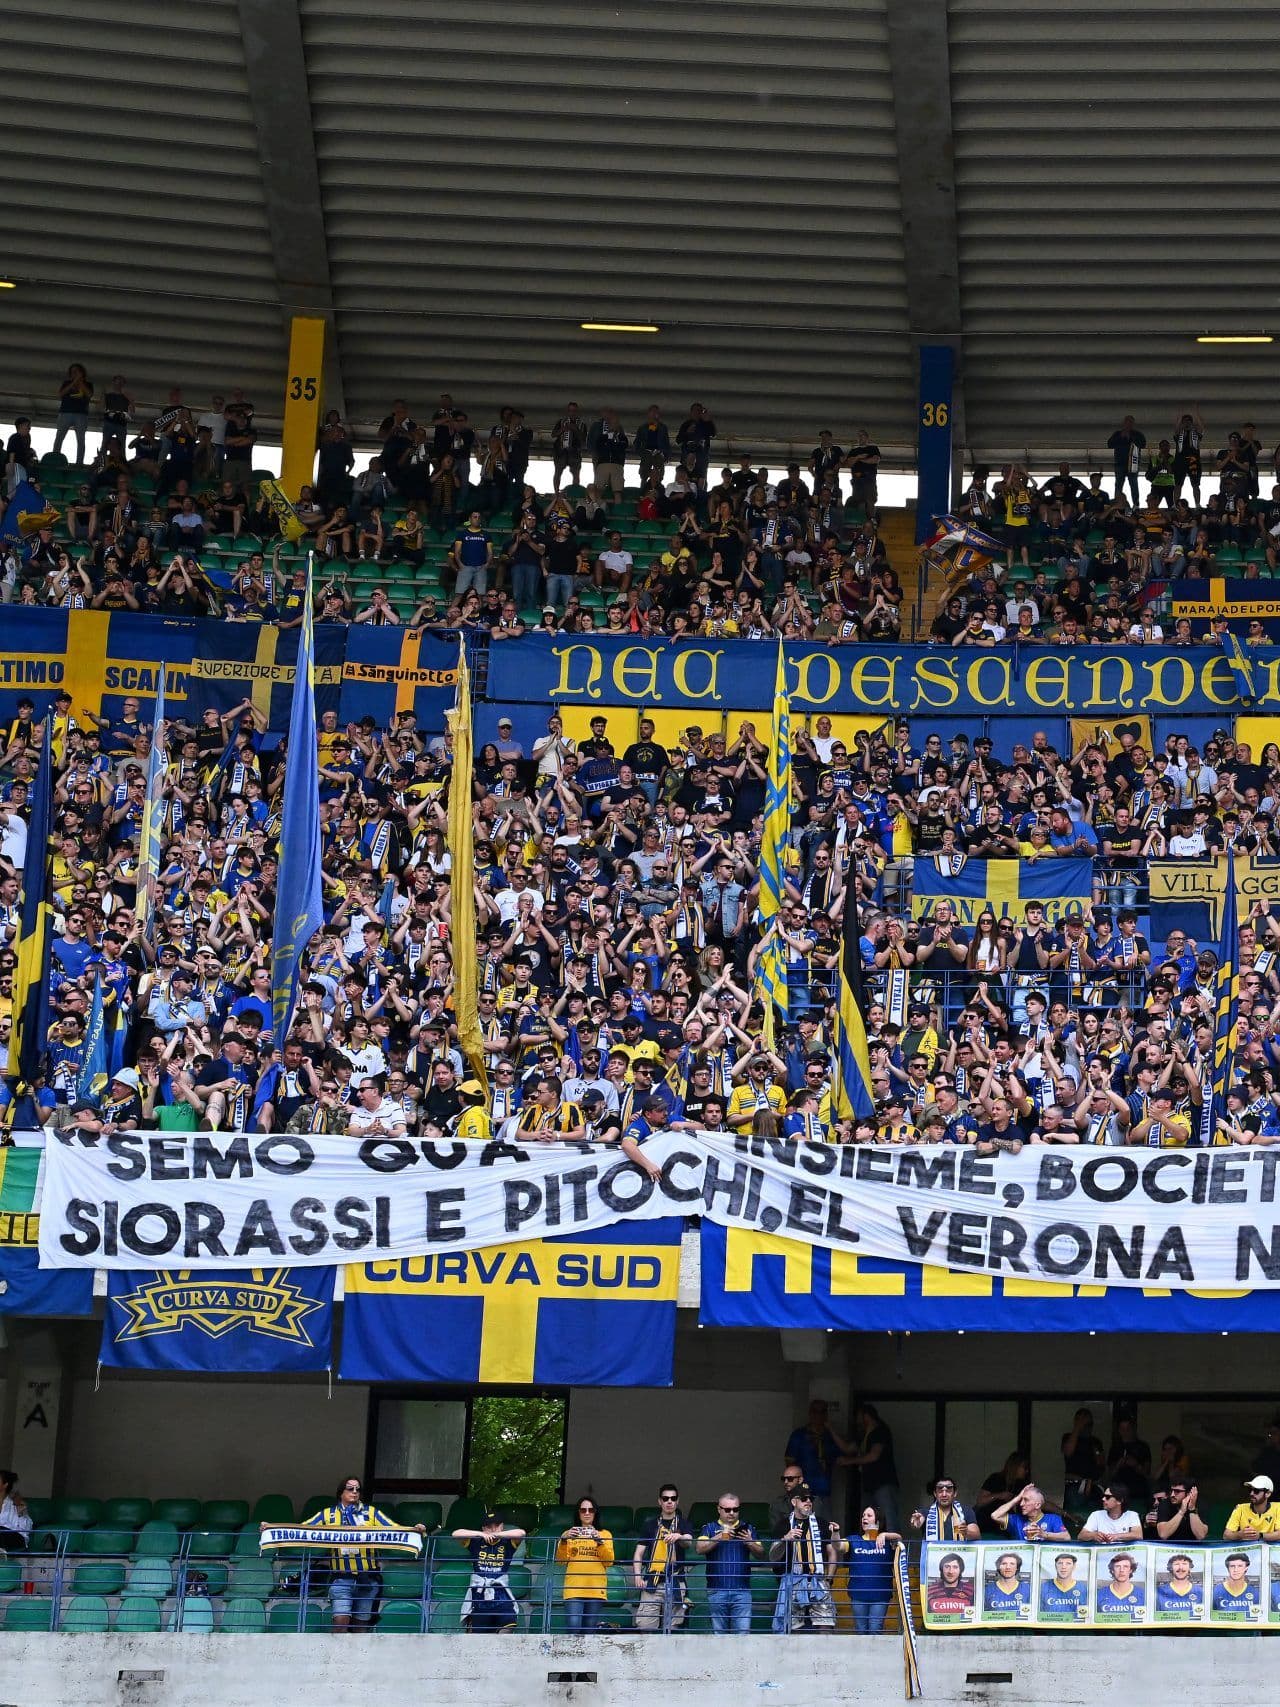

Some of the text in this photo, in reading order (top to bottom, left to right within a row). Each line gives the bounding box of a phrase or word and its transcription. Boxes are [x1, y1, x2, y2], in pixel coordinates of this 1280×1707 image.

[290, 377, 317, 401] 35
[923, 402, 947, 426] 36
[0, 660, 64, 684] TIMO
[549, 644, 725, 700] NEC
[59, 1195, 391, 1258] SIORASSI
[426, 1187, 467, 1243] E
[896, 1205, 1195, 1282] VERONA
[363, 1251, 663, 1289] CURVA SUD
[158, 1290, 279, 1312] CURVA SUD
[270, 1530, 409, 1543] VERONA CAMPIONE D'ITALIA
